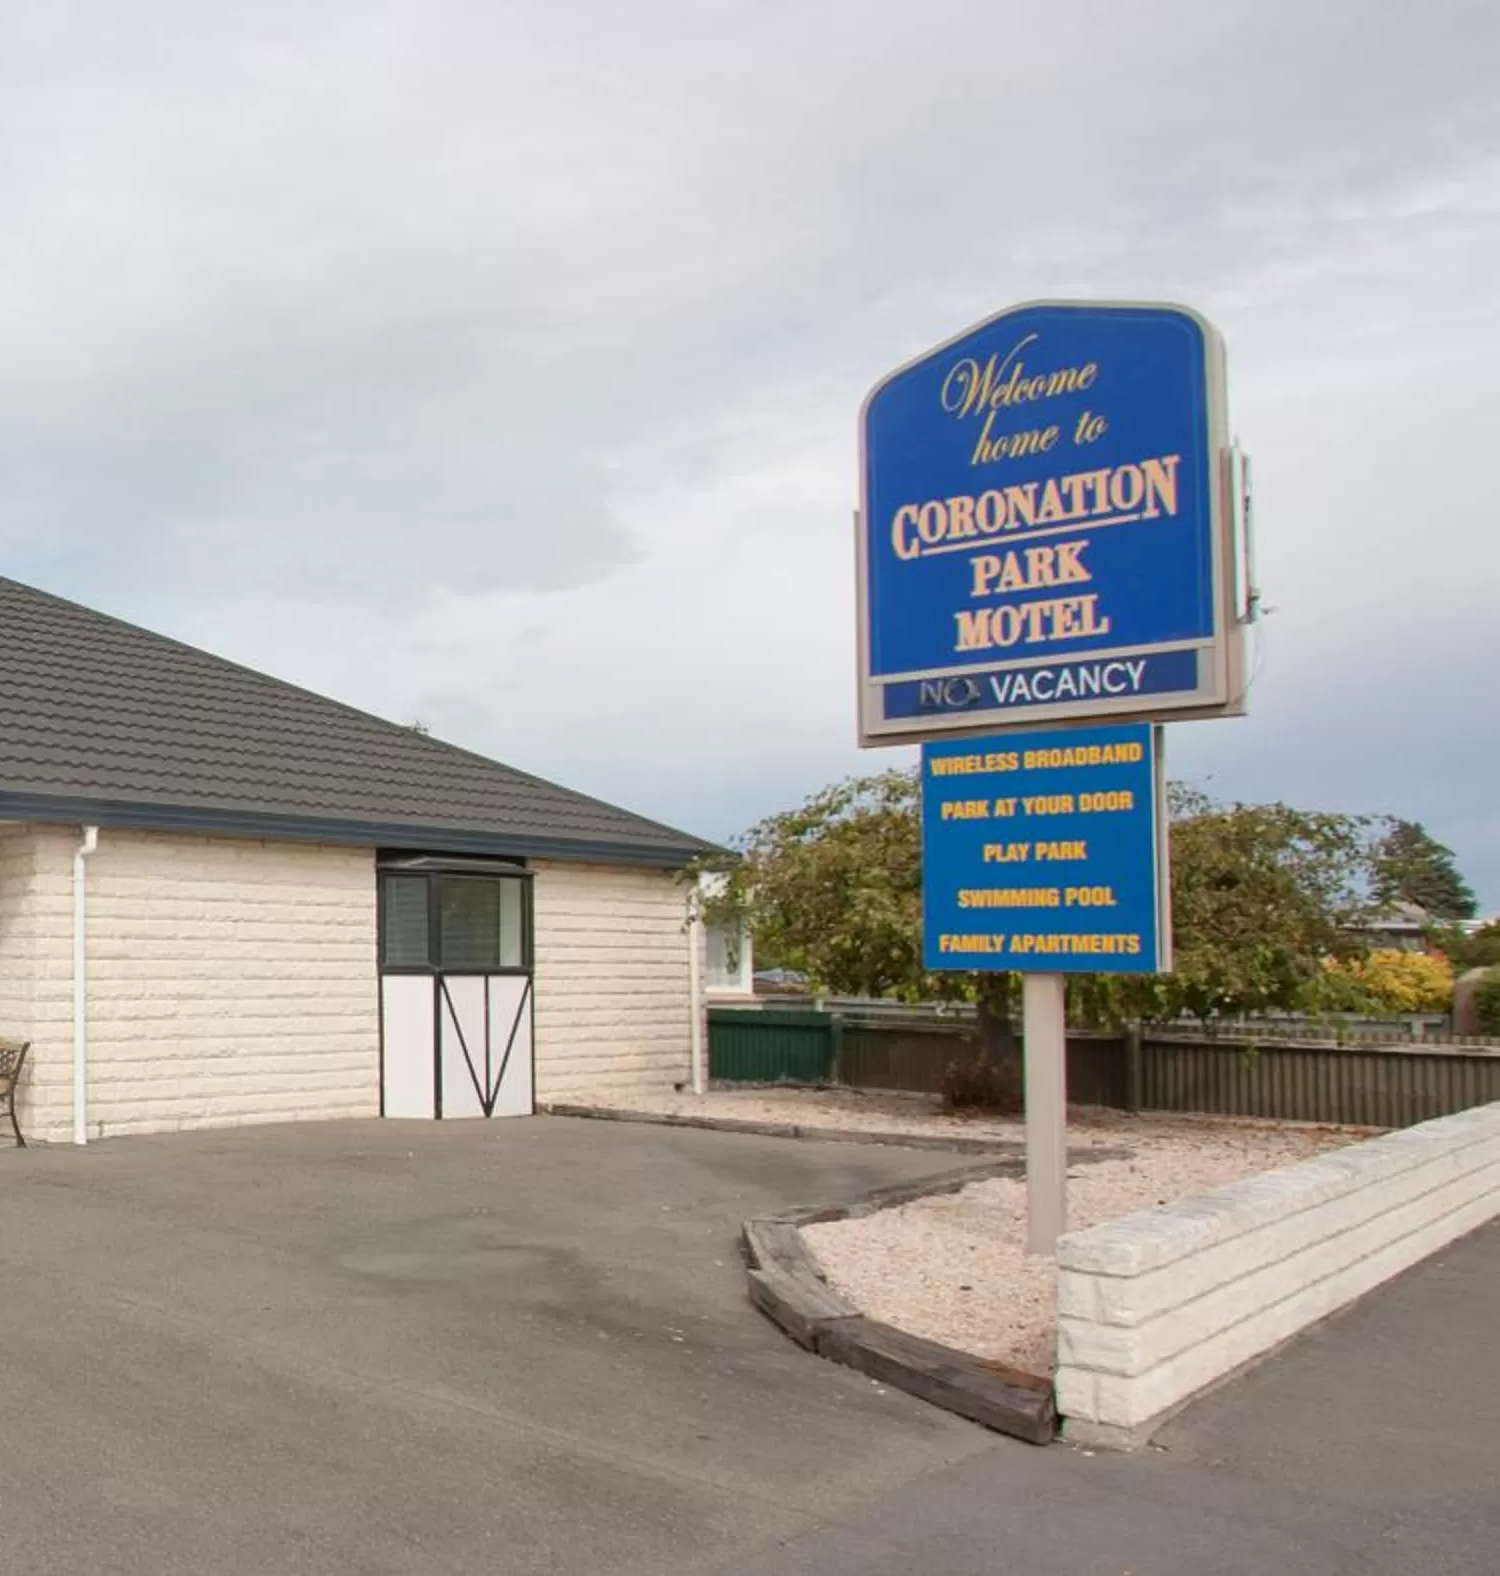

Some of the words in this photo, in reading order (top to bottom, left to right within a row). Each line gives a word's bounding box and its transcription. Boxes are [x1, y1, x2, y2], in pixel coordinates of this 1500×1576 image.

[941, 333, 1098, 420] Welcome
[970, 409, 1060, 466] home
[1074, 410, 1109, 445] to
[891, 454, 1181, 561] CORONATION
[969, 539, 1092, 598] PARK
[953, 593, 1110, 653] MOTEL
[989, 659, 1147, 704] VACANCY
[930, 751, 1019, 776] WIRELESS
[1023, 742, 1143, 770] BROADBAND
[941, 801, 988, 821] PARK
[995, 798, 1017, 817] AT
[1023, 795, 1074, 815] YOUR
[1078, 791, 1133, 812] DOOR
[983, 843, 1030, 863] PLAY
[1035, 841, 1088, 861] PARK
[957, 888, 1060, 909] SWIMMING
[1064, 886, 1117, 907] POOL
[939, 935, 1004, 954] FAMILY
[1009, 934, 1141, 955] APARTMENTS
